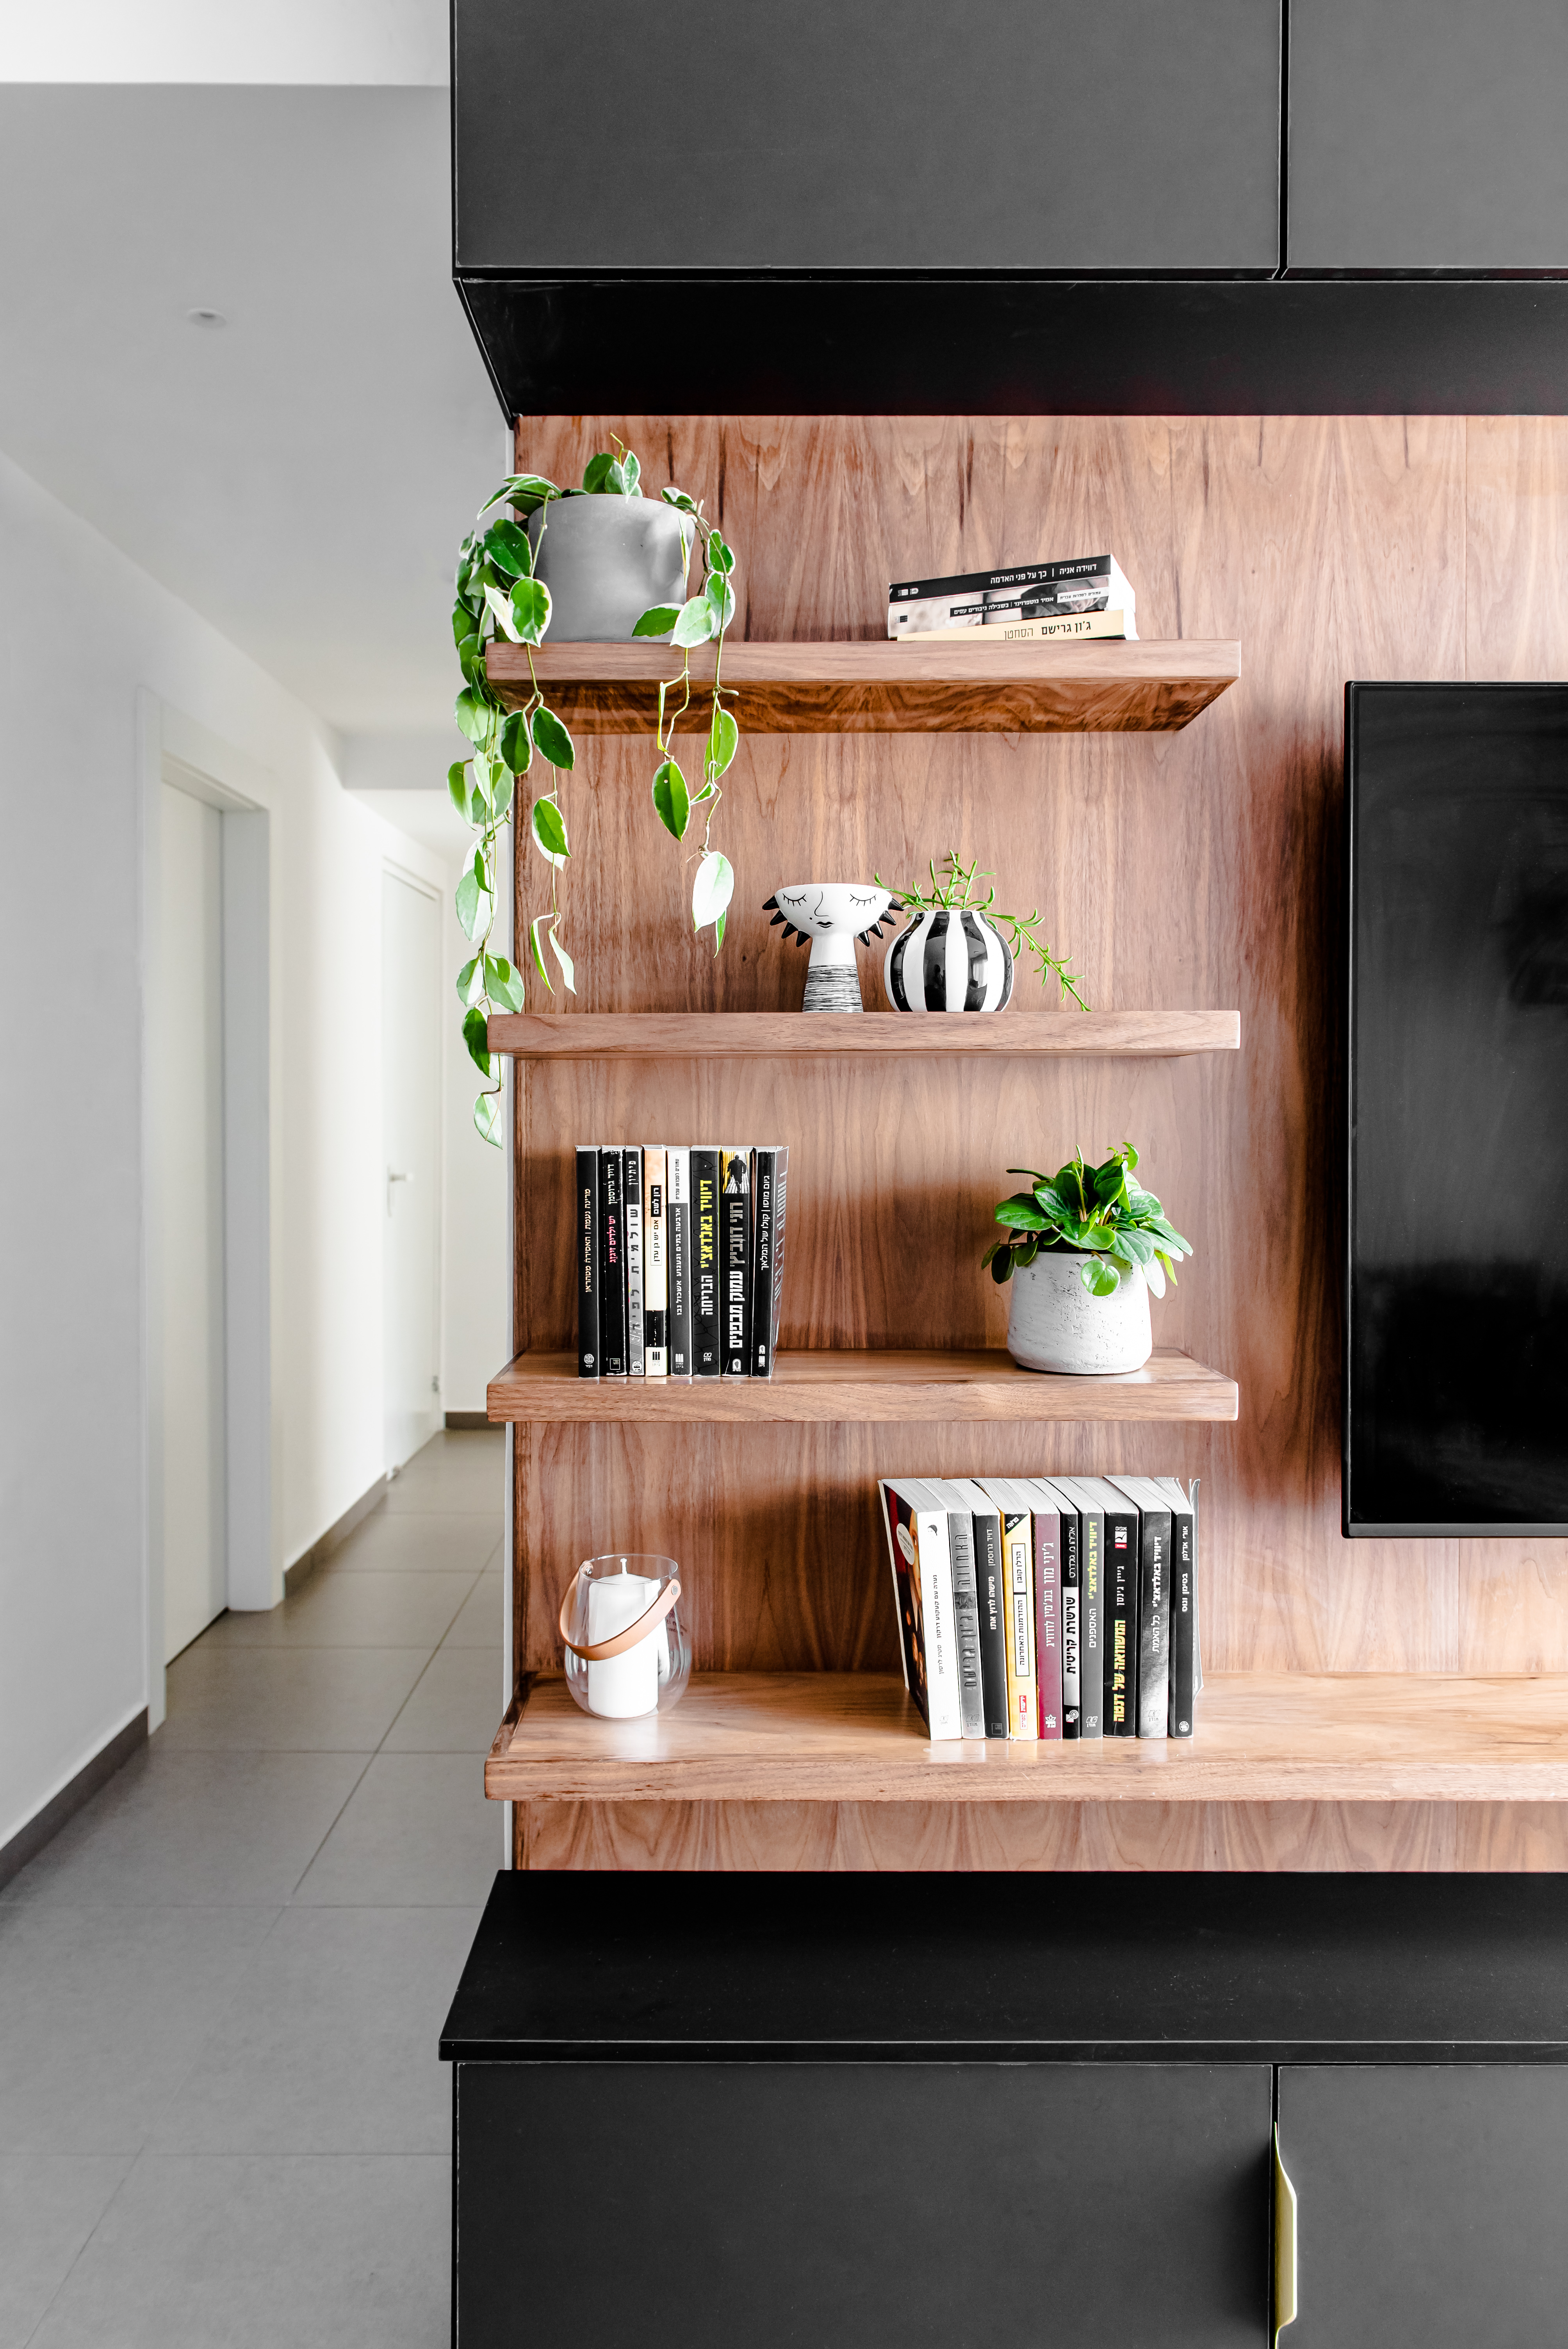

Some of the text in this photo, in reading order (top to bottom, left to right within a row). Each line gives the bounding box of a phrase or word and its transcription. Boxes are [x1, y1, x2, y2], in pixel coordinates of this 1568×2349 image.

[991, 575, 1014, 584] האדמה
[1038, 570, 1047, 579] כך
[1059, 567, 1074, 575] אניה
[1076, 564, 1097, 573] דווידה
[1013, 598, 1039, 607] גוטפרוינד
[1004, 621, 1091, 640] ג'ון גרישם הסחטן
[628, 1160, 639, 1185] פיתיון
[608, 1180, 618, 1205] גרוסמן
[608, 1215, 616, 1224] יש
[699, 1180, 713, 1268] דיוויד באלדאצ'י
[730, 1202, 743, 1223] רוני
[761, 1214, 770, 1229] קולו
[606, 1226, 616, 1246] ילדים
[654, 1220, 658, 1230] אם
[760, 1230, 768, 1242] של
[630, 1209, 640, 1274] שולמית
[760, 1244, 769, 1271] המלאך
[701, 1275, 713, 1315] הבריחה
[729, 1271, 745, 1349] עמוק מבפנים
[955, 1534, 971, 1585] האחווה
[987, 1543, 996, 1566] גרוסמן
[1153, 1536, 1162, 1561] דיוויד
[1181, 1542, 1190, 1561] אדלמן
[1087, 1551, 1097, 1599] באלדאצ'י
[987, 1599, 998, 1614] לרוץ
[1041, 1542, 1055, 1647] ג'יני מון בנג'מין לודוויג
[1066, 1597, 1077, 1674] שרשרת קריטית
[1150, 1615, 1160, 1653] כל האמת
[959, 1616, 977, 1687] ג'ון גרישם
[1112, 1620, 1126, 1722] המשוואה של דנטה
